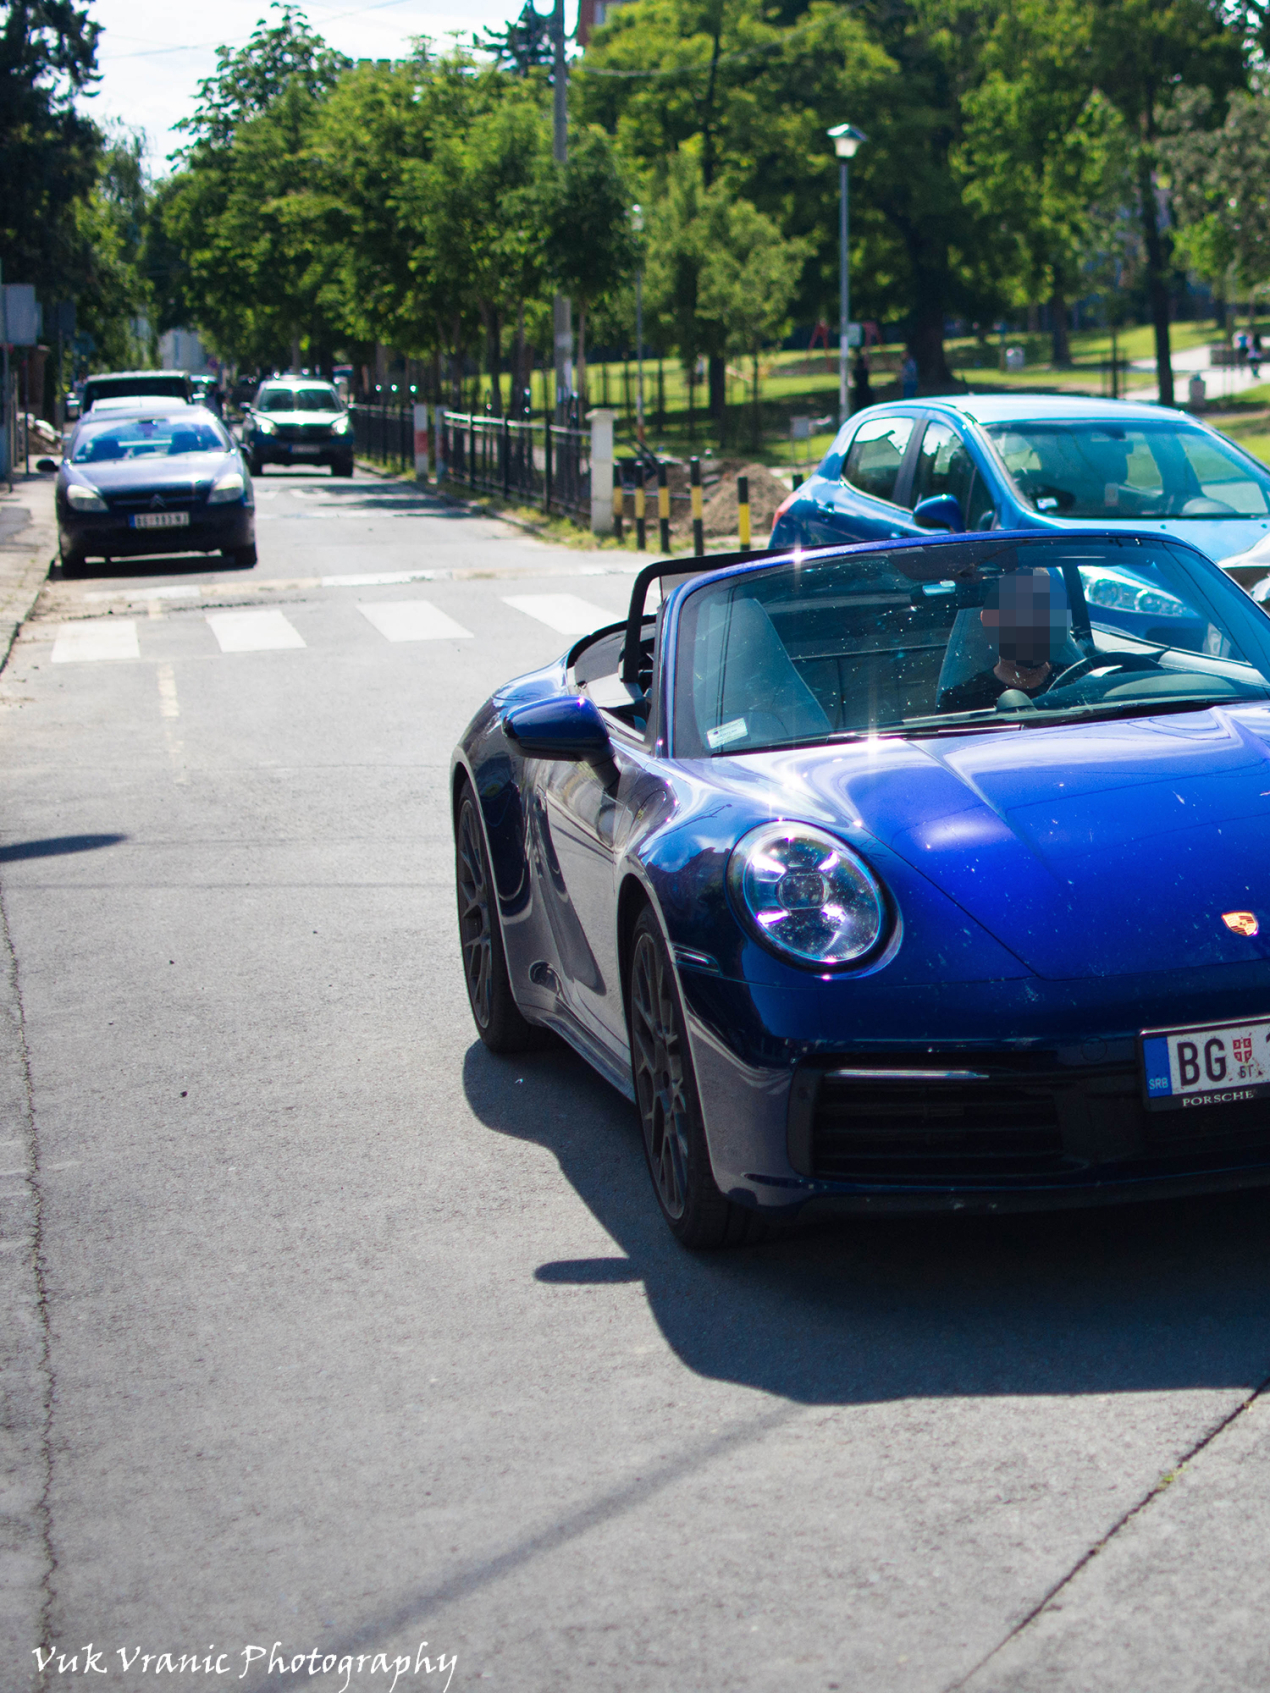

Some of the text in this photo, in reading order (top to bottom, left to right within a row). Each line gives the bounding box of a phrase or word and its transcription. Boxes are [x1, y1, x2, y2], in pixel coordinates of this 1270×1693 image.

[1177, 1037, 1227, 1087] BG
[1149, 1077, 1169, 1090] SRB
[1182, 1090, 1254, 1107] PORSCHE
